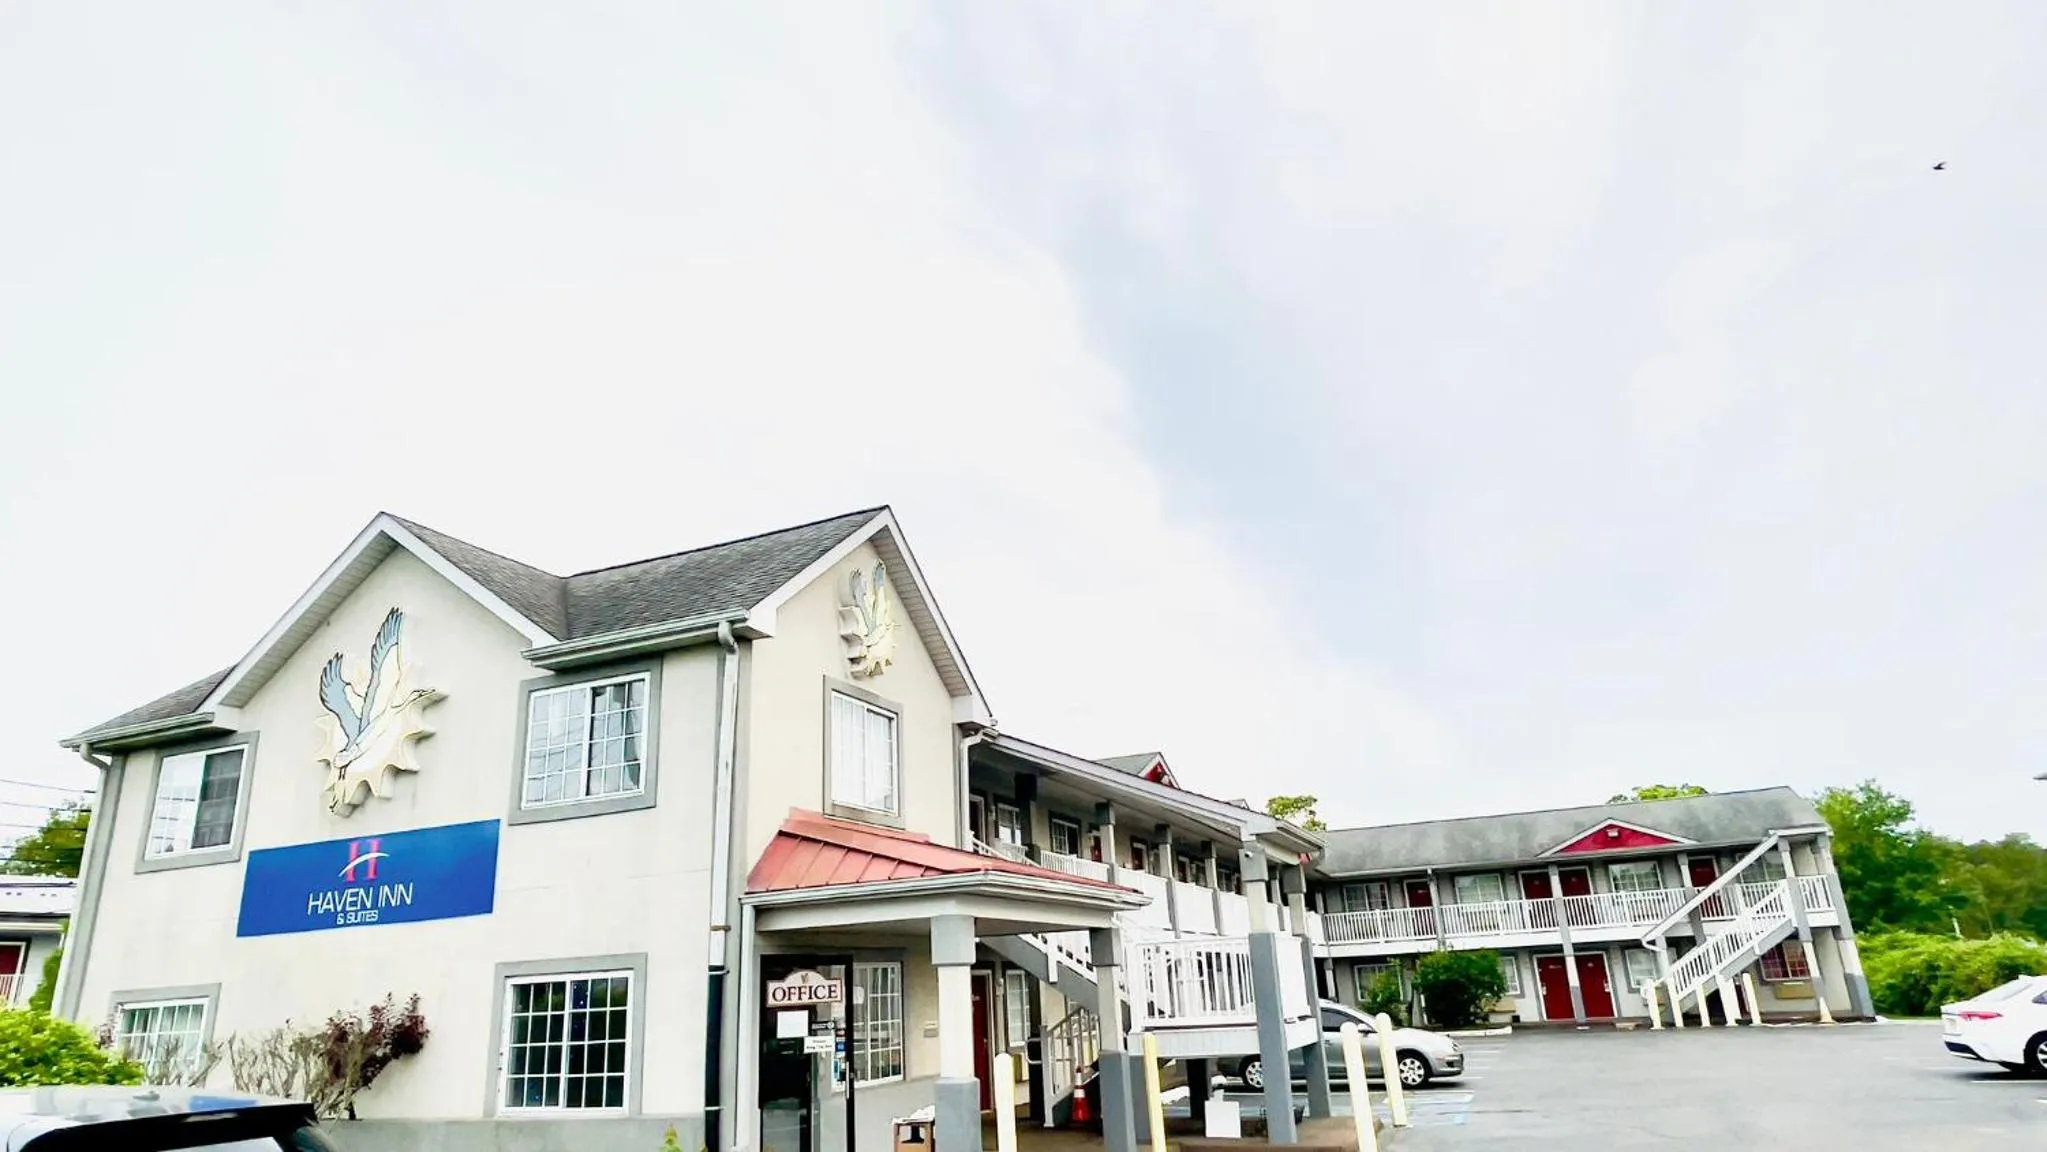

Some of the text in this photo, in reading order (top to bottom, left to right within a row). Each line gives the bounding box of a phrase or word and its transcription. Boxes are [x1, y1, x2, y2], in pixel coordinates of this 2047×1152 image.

[307, 882, 413, 915] HAVEN INN
[336, 910, 379, 925] & SUITES
[772, 984, 838, 1002] OFFICE
